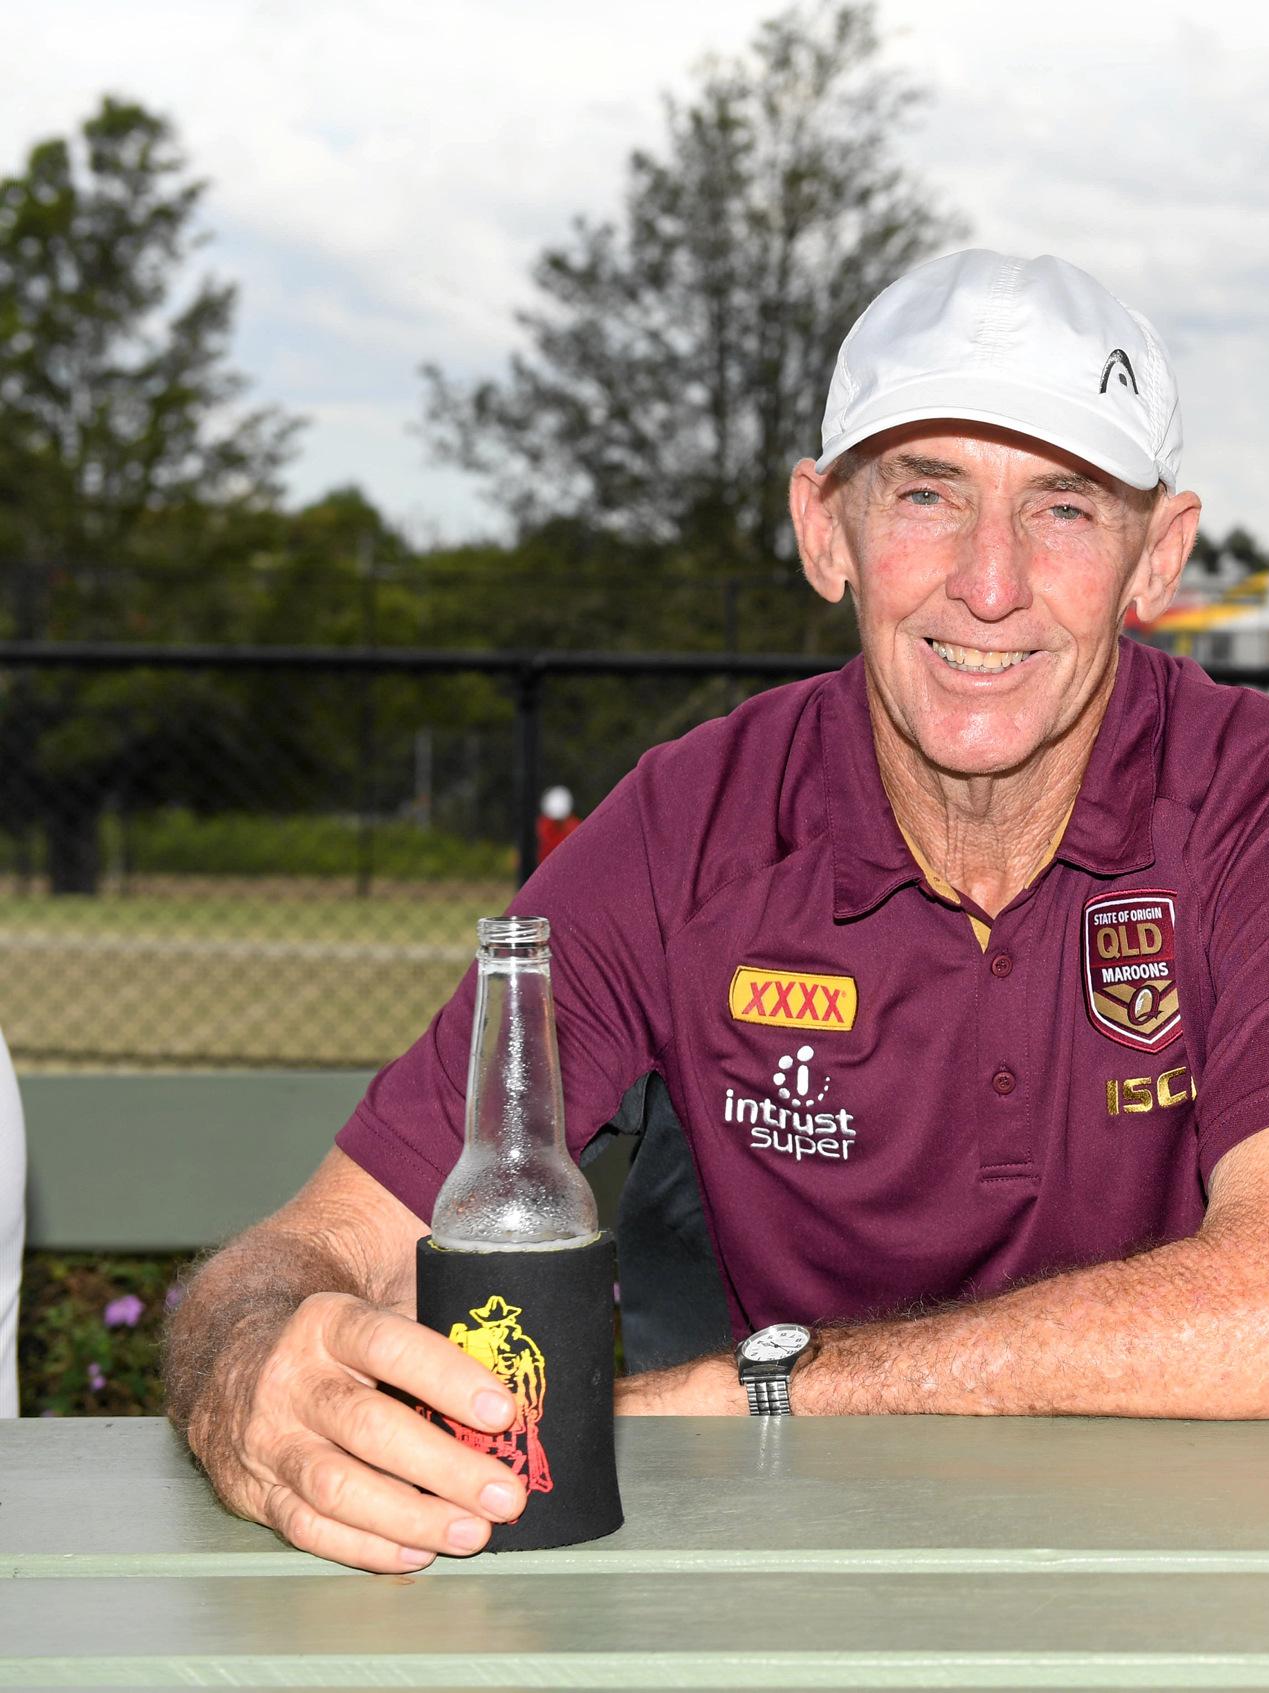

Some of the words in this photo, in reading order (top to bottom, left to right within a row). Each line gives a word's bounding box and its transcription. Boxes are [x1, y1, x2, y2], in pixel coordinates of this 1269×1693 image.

[1093, 913, 1117, 926] STATE
[1118, 910, 1130, 924] OF
[1132, 907, 1163, 921] ORIGIN
[1096, 922, 1163, 960] QLD
[1102, 962, 1169, 983] MAROONS
[741, 981, 845, 1023] XXXX
[1106, 1066, 1198, 1116] ISC
[724, 1088, 857, 1136] intrust
[750, 1126, 856, 1160] super
